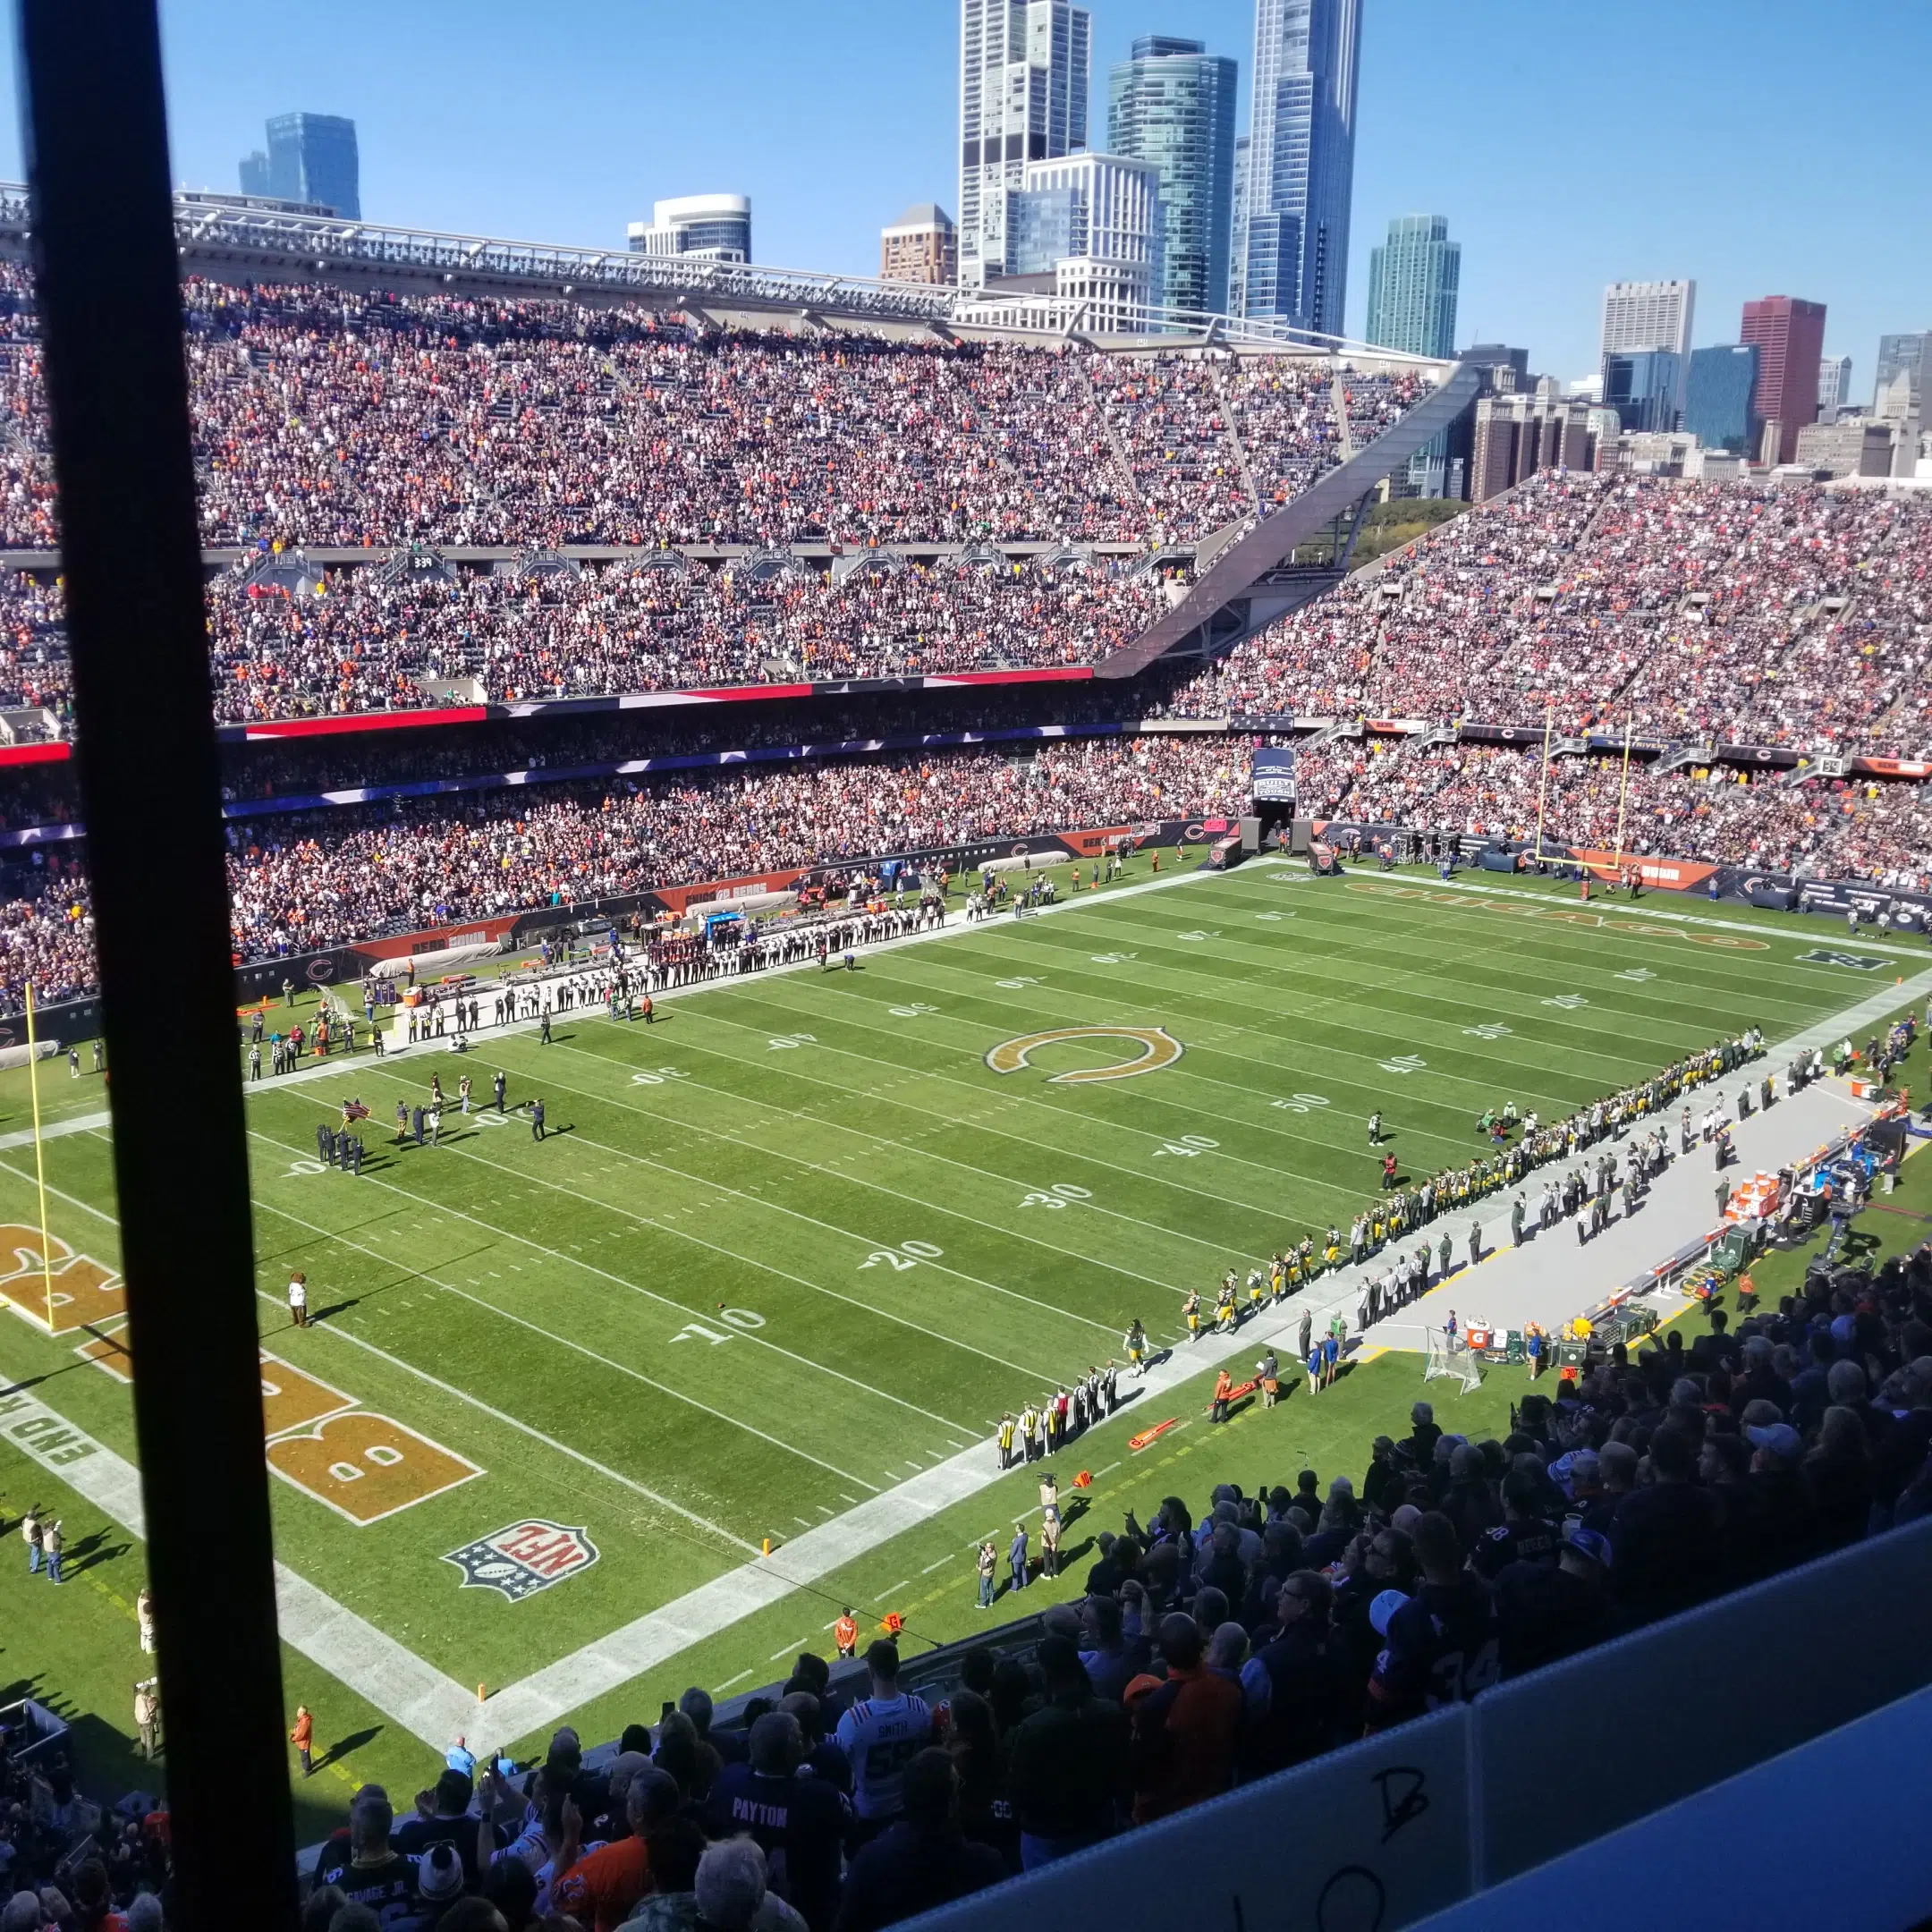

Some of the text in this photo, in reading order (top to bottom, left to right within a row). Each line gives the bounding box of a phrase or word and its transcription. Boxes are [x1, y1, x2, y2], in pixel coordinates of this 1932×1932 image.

[414, 556, 432, 567] 3:39
[1344, 883, 1771, 950] CHICAGO
[888, 1002, 940, 1017] 50
[1541, 994, 1589, 1009] 20
[768, 1032, 818, 1049] 40
[1462, 1023, 1513, 1039] 30
[1377, 1055, 1428, 1073] 40
[631, 1066, 691, 1086] 30
[1270, 1093, 1331, 1113] 50
[1162, 1134, 1221, 1157] 40
[1023, 1182, 1093, 1210] 30
[868, 1240, 944, 1271] 20
[682, 1308, 767, 1345] 10
[10, 1418, 98, 1467] END
[497, 1525, 584, 1576] NFL
[878, 1719, 909, 1739] SMITH
[733, 1796, 788, 1828] PAYTON
